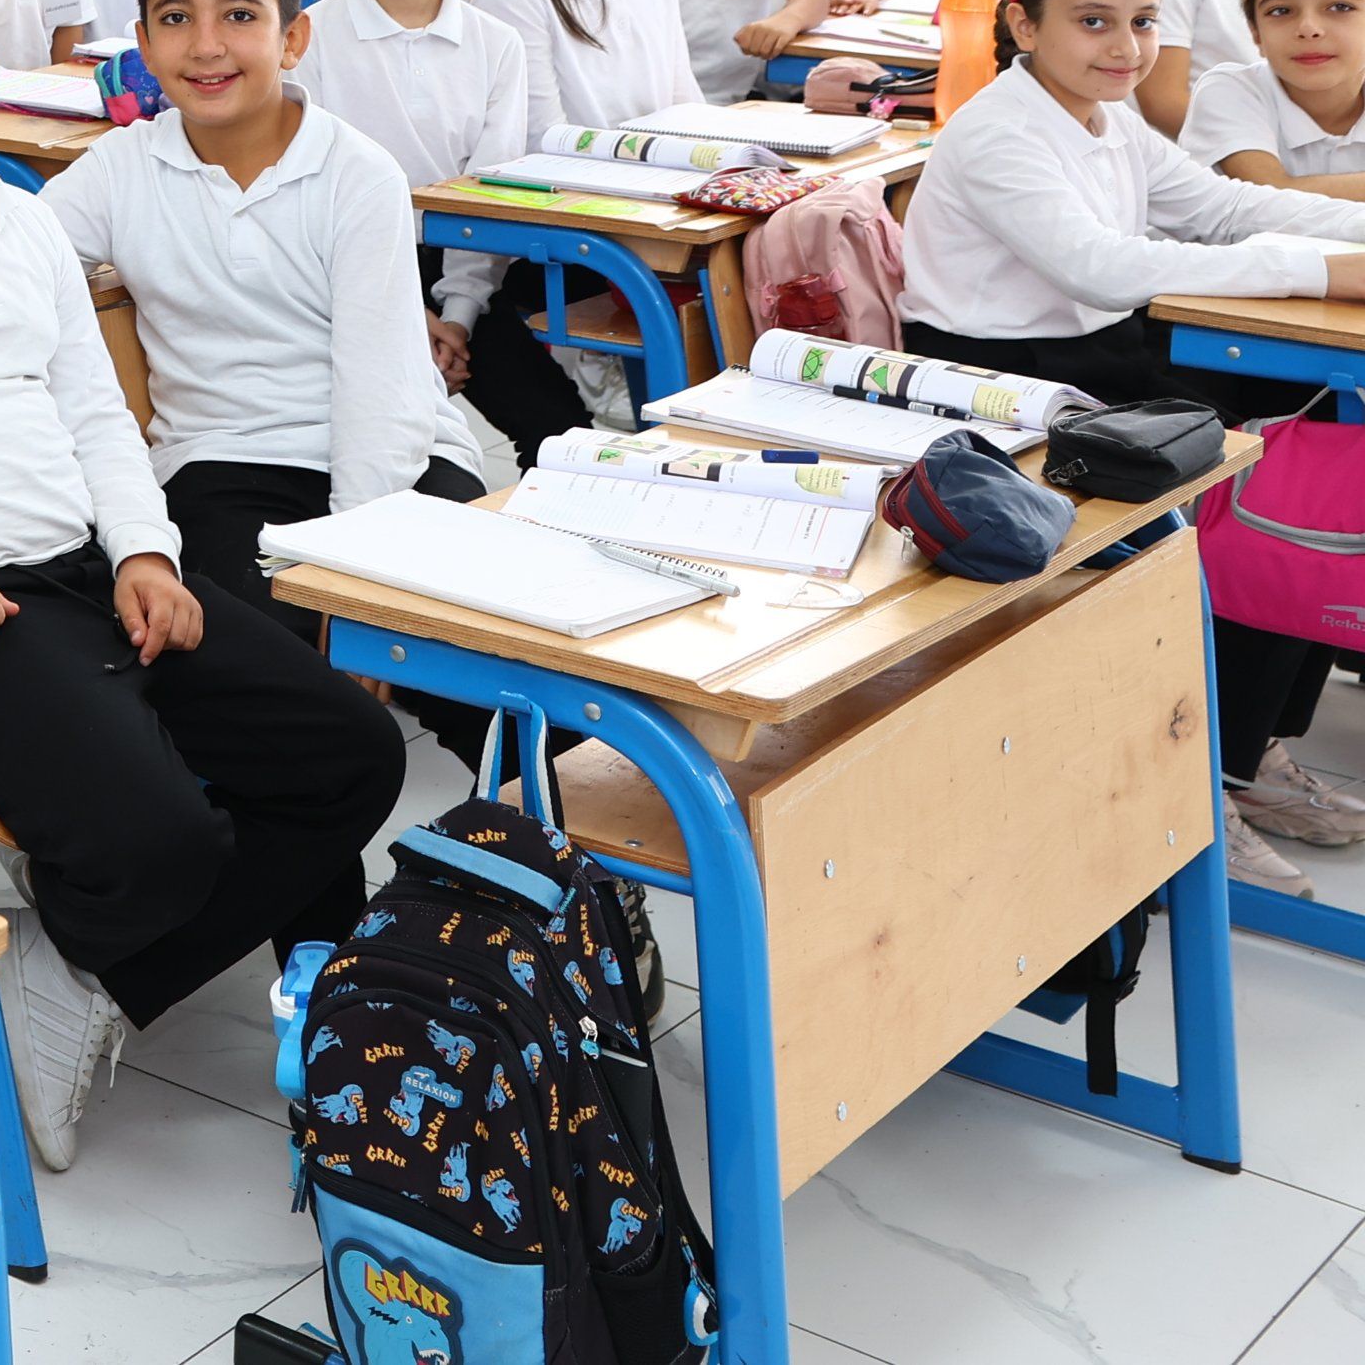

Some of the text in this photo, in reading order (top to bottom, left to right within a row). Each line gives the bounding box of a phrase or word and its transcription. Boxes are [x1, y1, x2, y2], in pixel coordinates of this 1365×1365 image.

[365, 1043, 405, 1064] GRRRR
[405, 1076, 457, 1103] RELAXION
[422, 1110, 446, 1153] GRRRR
[366, 1144, 407, 1168] GRRRR
[365, 1261, 451, 1317] GRRRR
